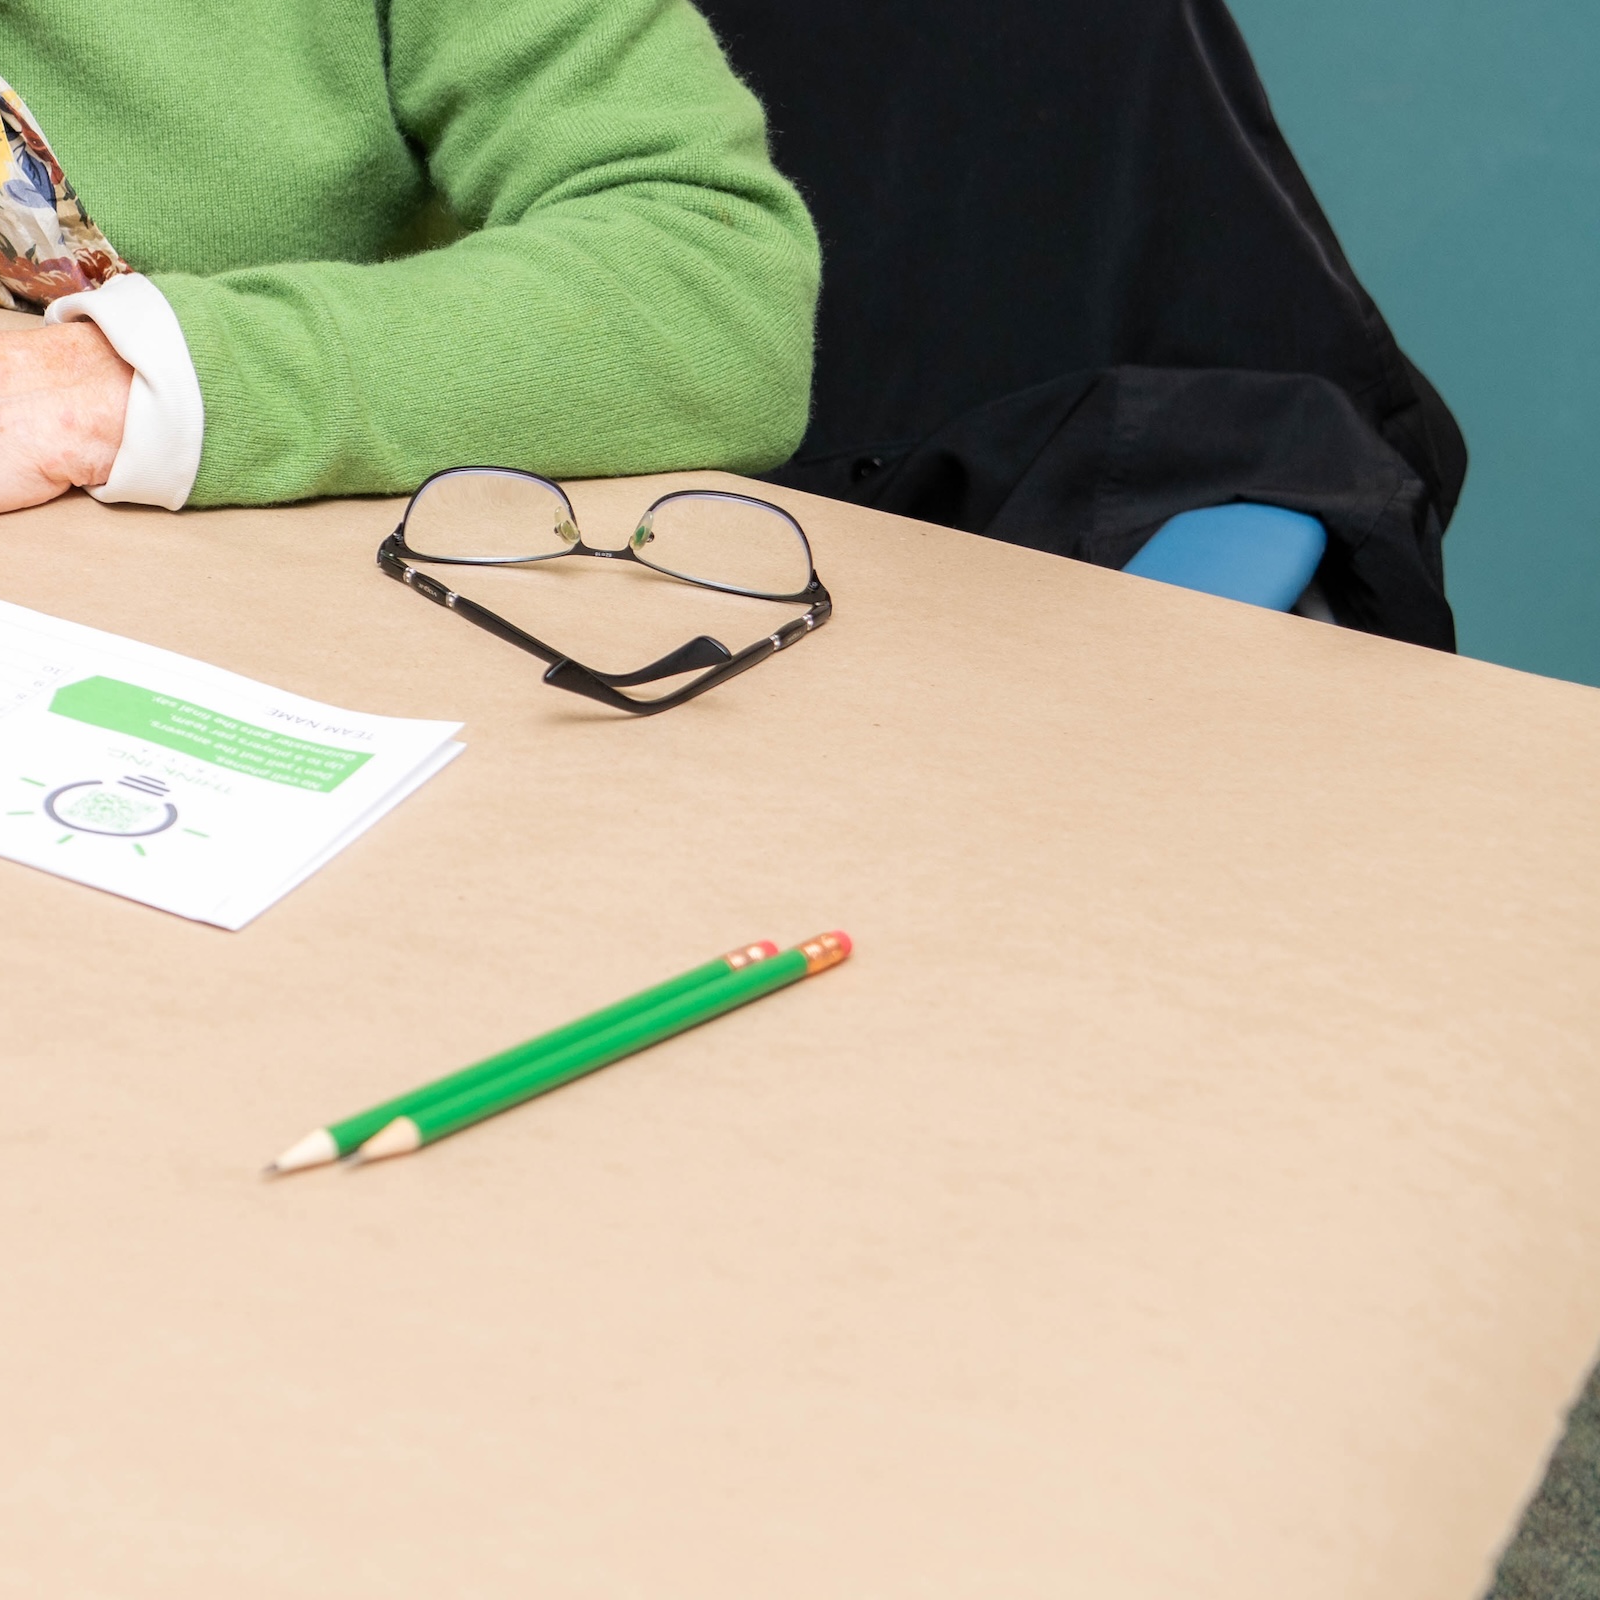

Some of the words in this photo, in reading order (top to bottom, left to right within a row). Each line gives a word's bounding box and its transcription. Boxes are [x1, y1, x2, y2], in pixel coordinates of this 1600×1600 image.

[42, 665, 62, 675] 10
[152, 696, 178, 708] say.
[178, 705, 212, 720] final
[170, 713, 208, 732] team.
[213, 717, 239, 730] the
[149, 719, 212, 745] answers.
[208, 730, 237, 741] per
[239, 726, 272, 740] gets
[323, 725, 375, 741] TEAM
[213, 742, 239, 755] the
[238, 737, 294, 758] players
[271, 737, 357, 761] Quizmaster
[239, 751, 265, 763] out
[306, 757, 322, 766] to
[215, 755, 271, 776] phones.
[264, 759, 294, 771] yell
[323, 760, 346, 771] Up
[270, 773, 300, 784] cell
[294, 766, 334, 781] Don't
[163, 766, 231, 795] THINK
[300, 779, 321, 789] No
